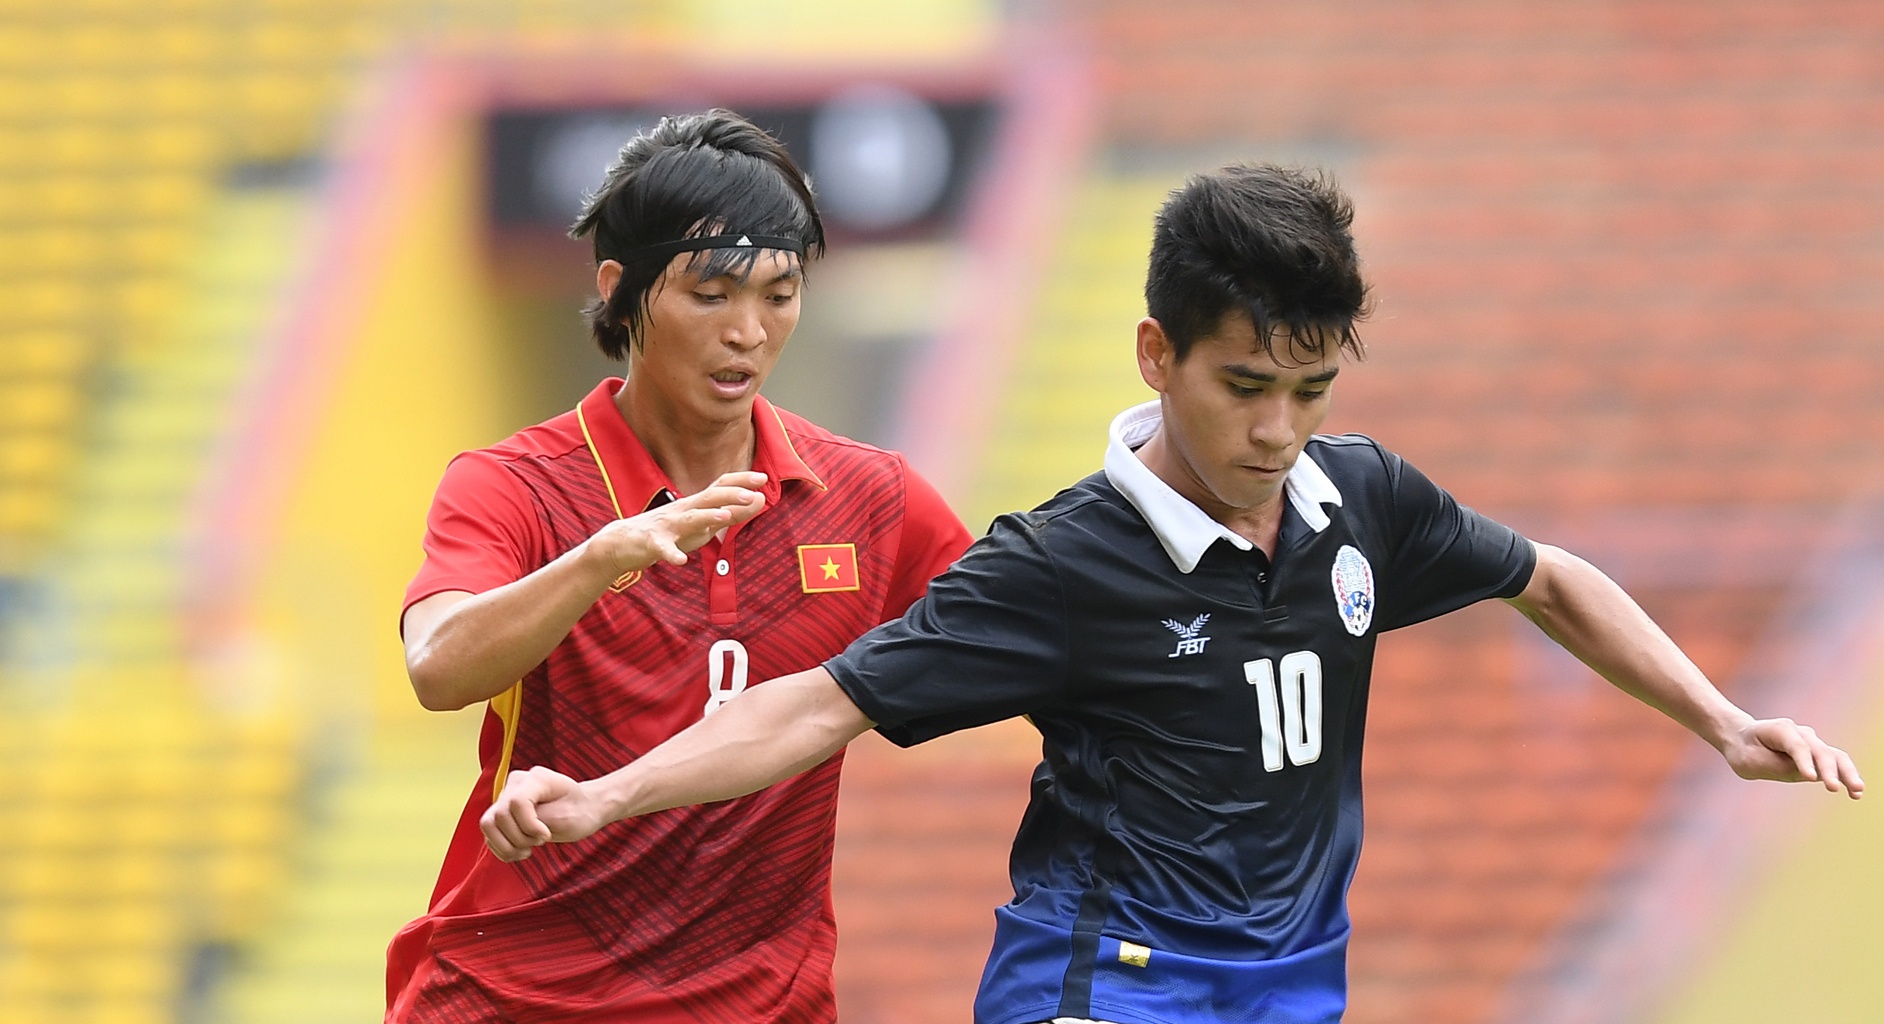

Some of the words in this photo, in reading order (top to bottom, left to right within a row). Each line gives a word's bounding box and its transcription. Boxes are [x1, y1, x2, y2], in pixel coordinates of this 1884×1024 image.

[704, 639, 749, 718] 8
[1168, 637, 1211, 658] FBT
[1243, 650, 1323, 773] 10
